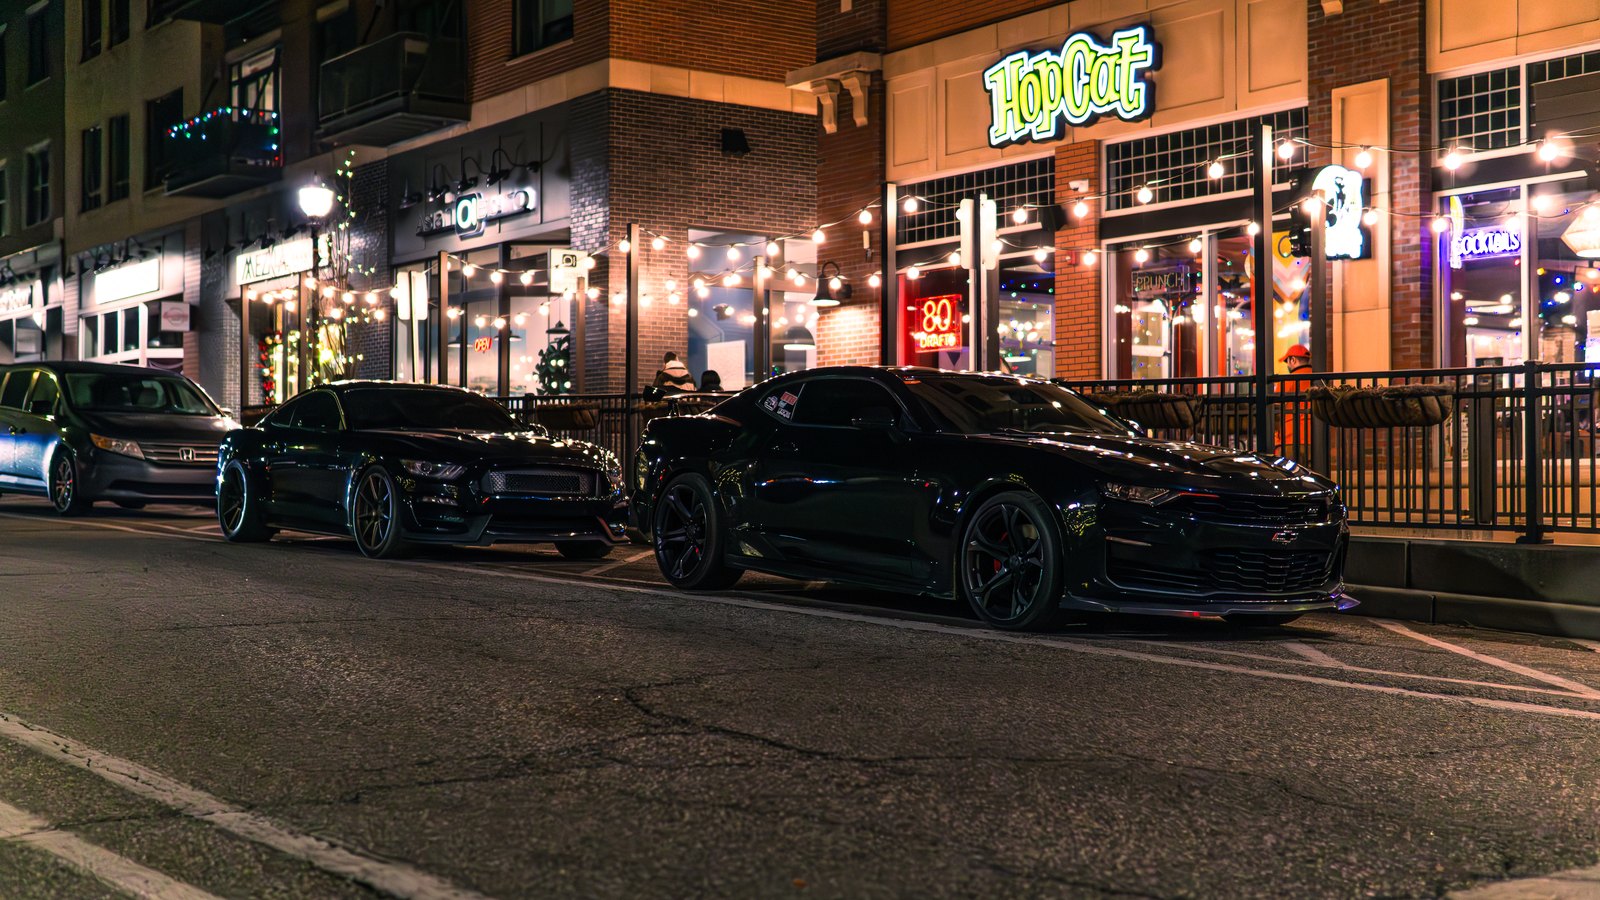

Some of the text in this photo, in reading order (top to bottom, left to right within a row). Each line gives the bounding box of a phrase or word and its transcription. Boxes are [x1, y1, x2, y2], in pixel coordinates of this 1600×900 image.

[986, 29, 1152, 143] HopCat
[923, 299, 951, 332] 80
[474, 337, 492, 352] OPEN
